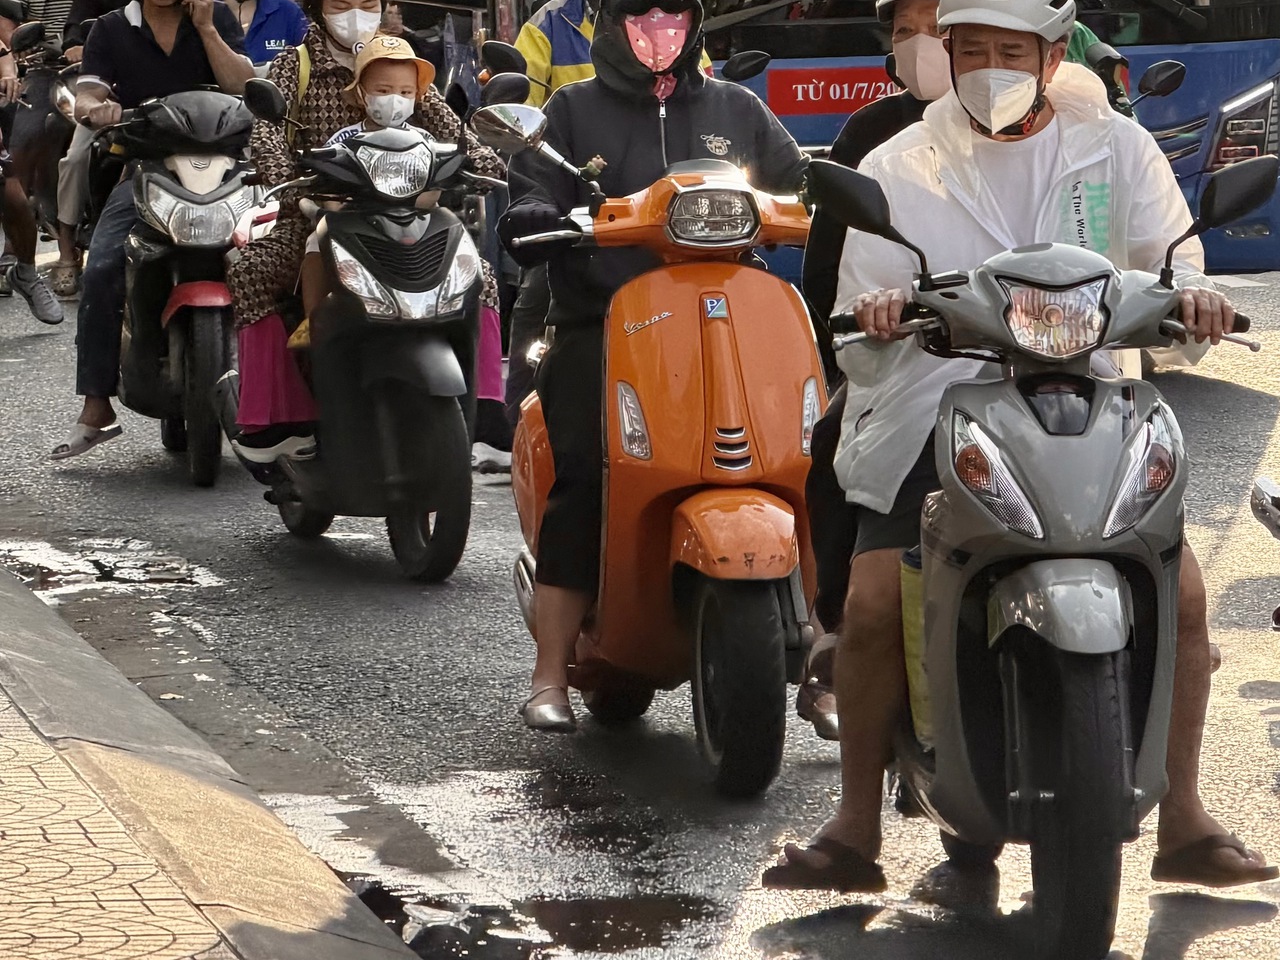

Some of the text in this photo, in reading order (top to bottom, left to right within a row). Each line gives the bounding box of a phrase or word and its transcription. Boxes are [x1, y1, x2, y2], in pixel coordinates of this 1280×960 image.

[792, 79, 901, 101] TỪ 01/7/20
[1072, 194, 1082, 215] The
